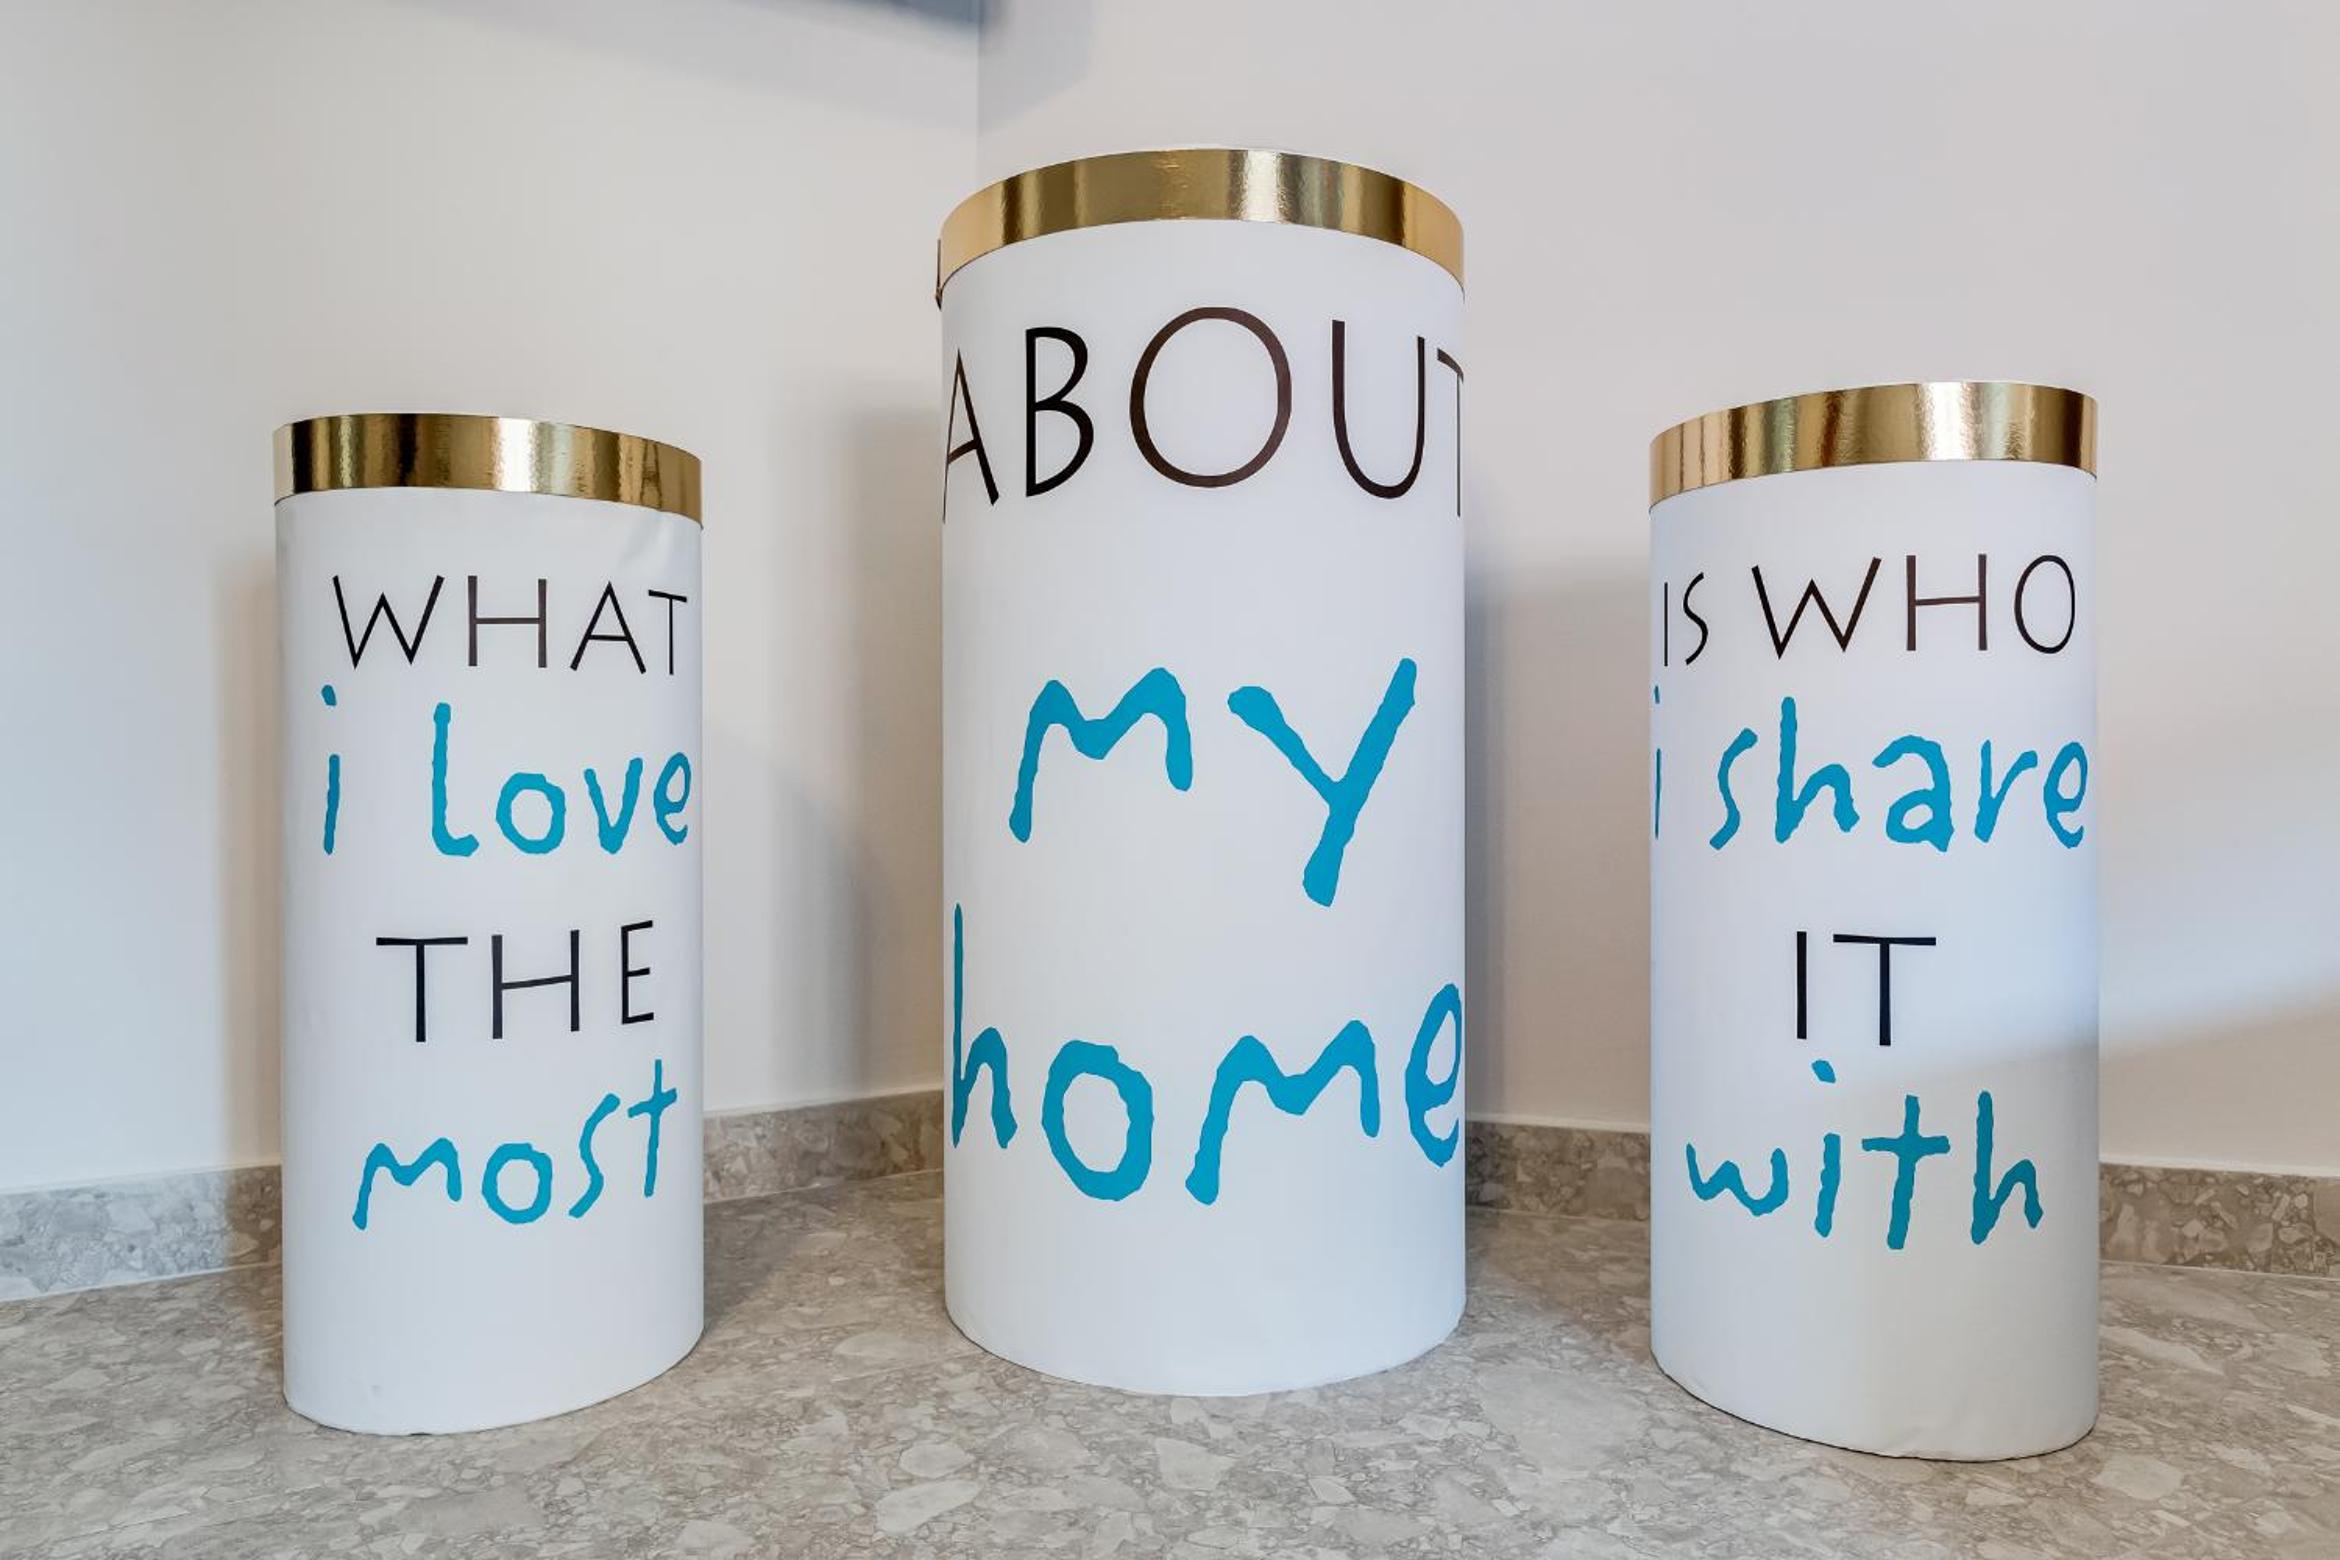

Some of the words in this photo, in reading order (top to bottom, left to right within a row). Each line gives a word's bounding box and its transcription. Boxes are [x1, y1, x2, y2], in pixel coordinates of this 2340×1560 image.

[942, 307, 1464, 523] ABOUT
[333, 575, 688, 676] WHAT
[1663, 572, 1709, 667] IS
[1752, 554, 2076, 660] WHO
[322, 685, 341, 855] i
[432, 703, 692, 858] love
[1009, 658, 1418, 907] my
[1710, 697, 2088, 853] share
[376, 920, 655, 1043] THE
[952, 902, 1463, 1206] home
[1797, 931, 1937, 1047] IT
[352, 1060, 678, 1231] most
[1686, 1060, 2044, 1250] with
